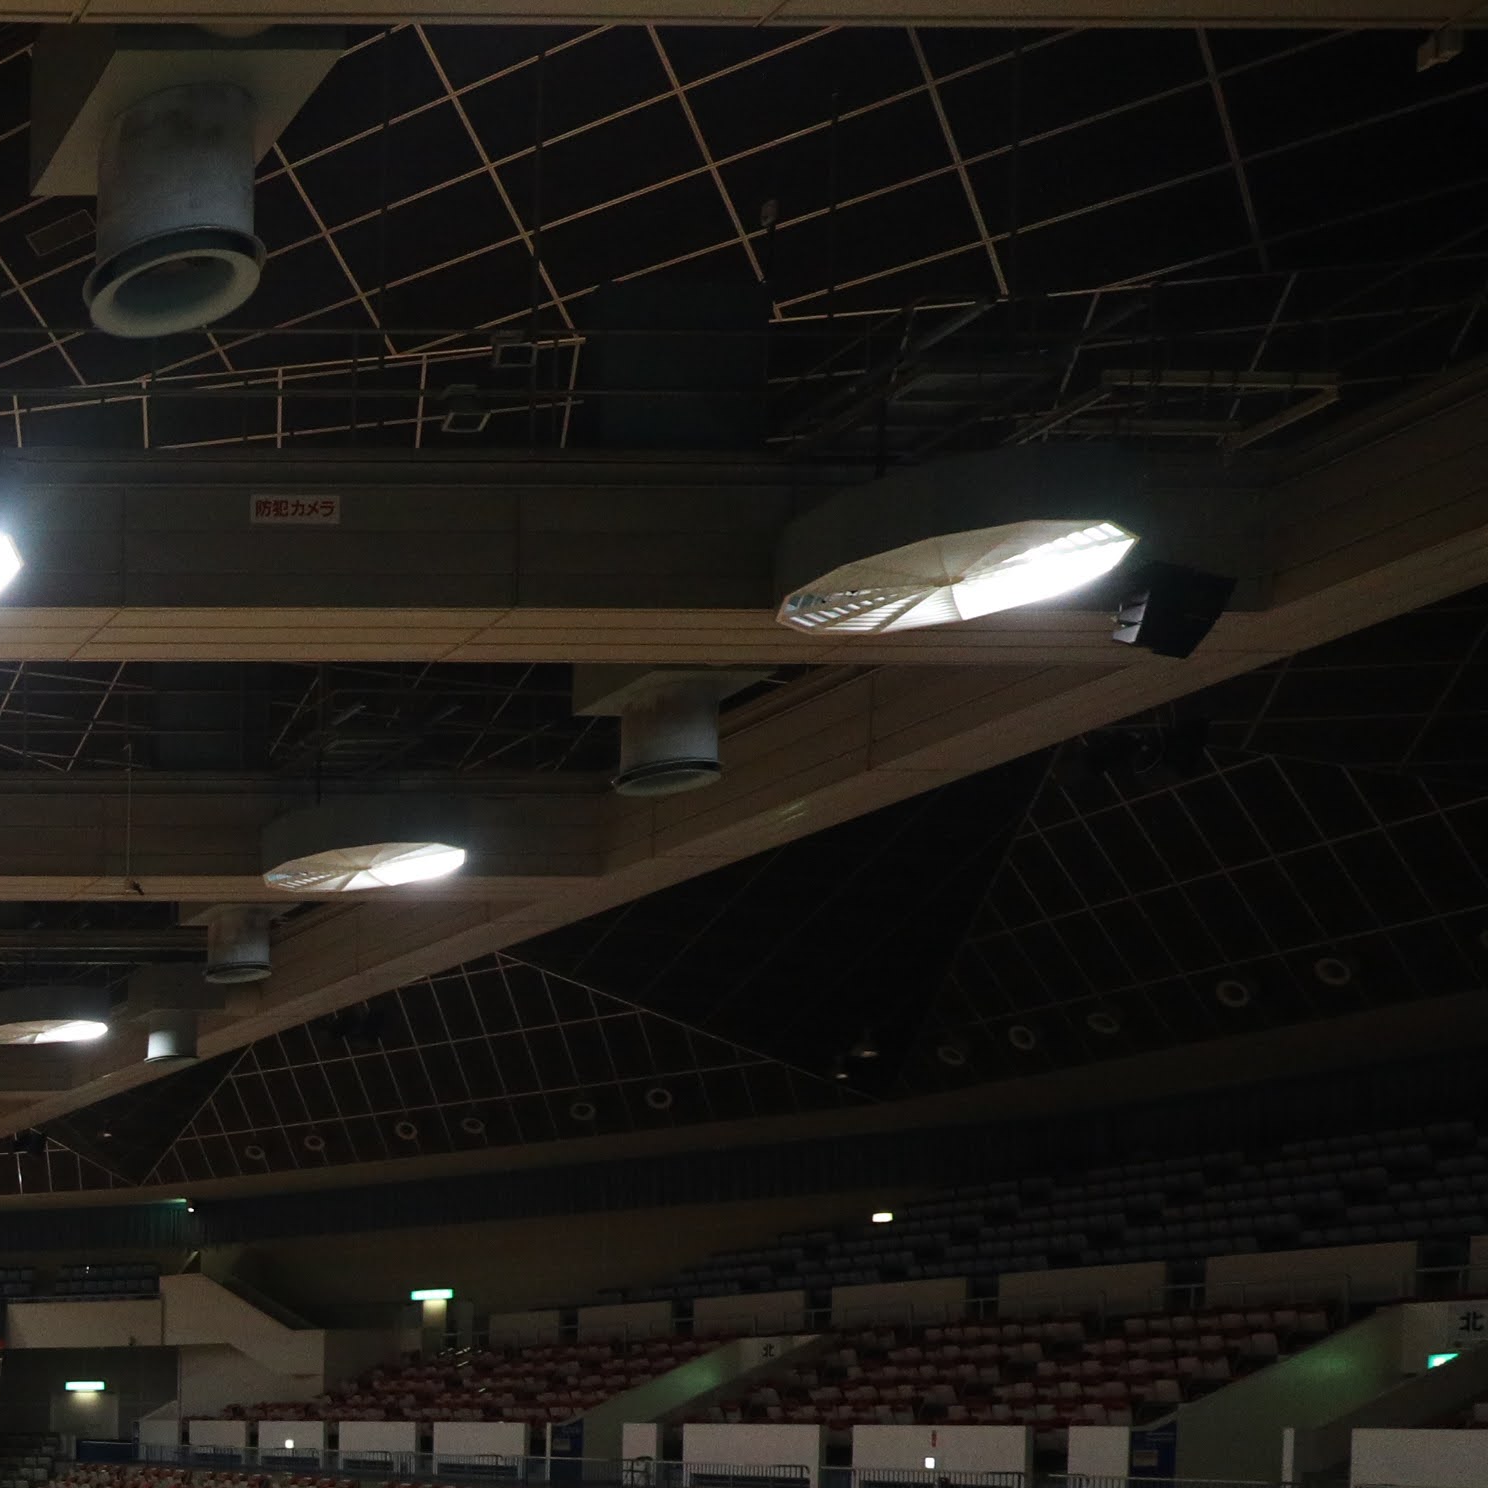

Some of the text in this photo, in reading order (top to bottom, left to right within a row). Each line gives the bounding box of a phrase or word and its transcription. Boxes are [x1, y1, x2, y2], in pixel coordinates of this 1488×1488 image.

[255, 500, 335, 517] 防犯カメラ
[1460, 1312, 1484, 1332] 北
